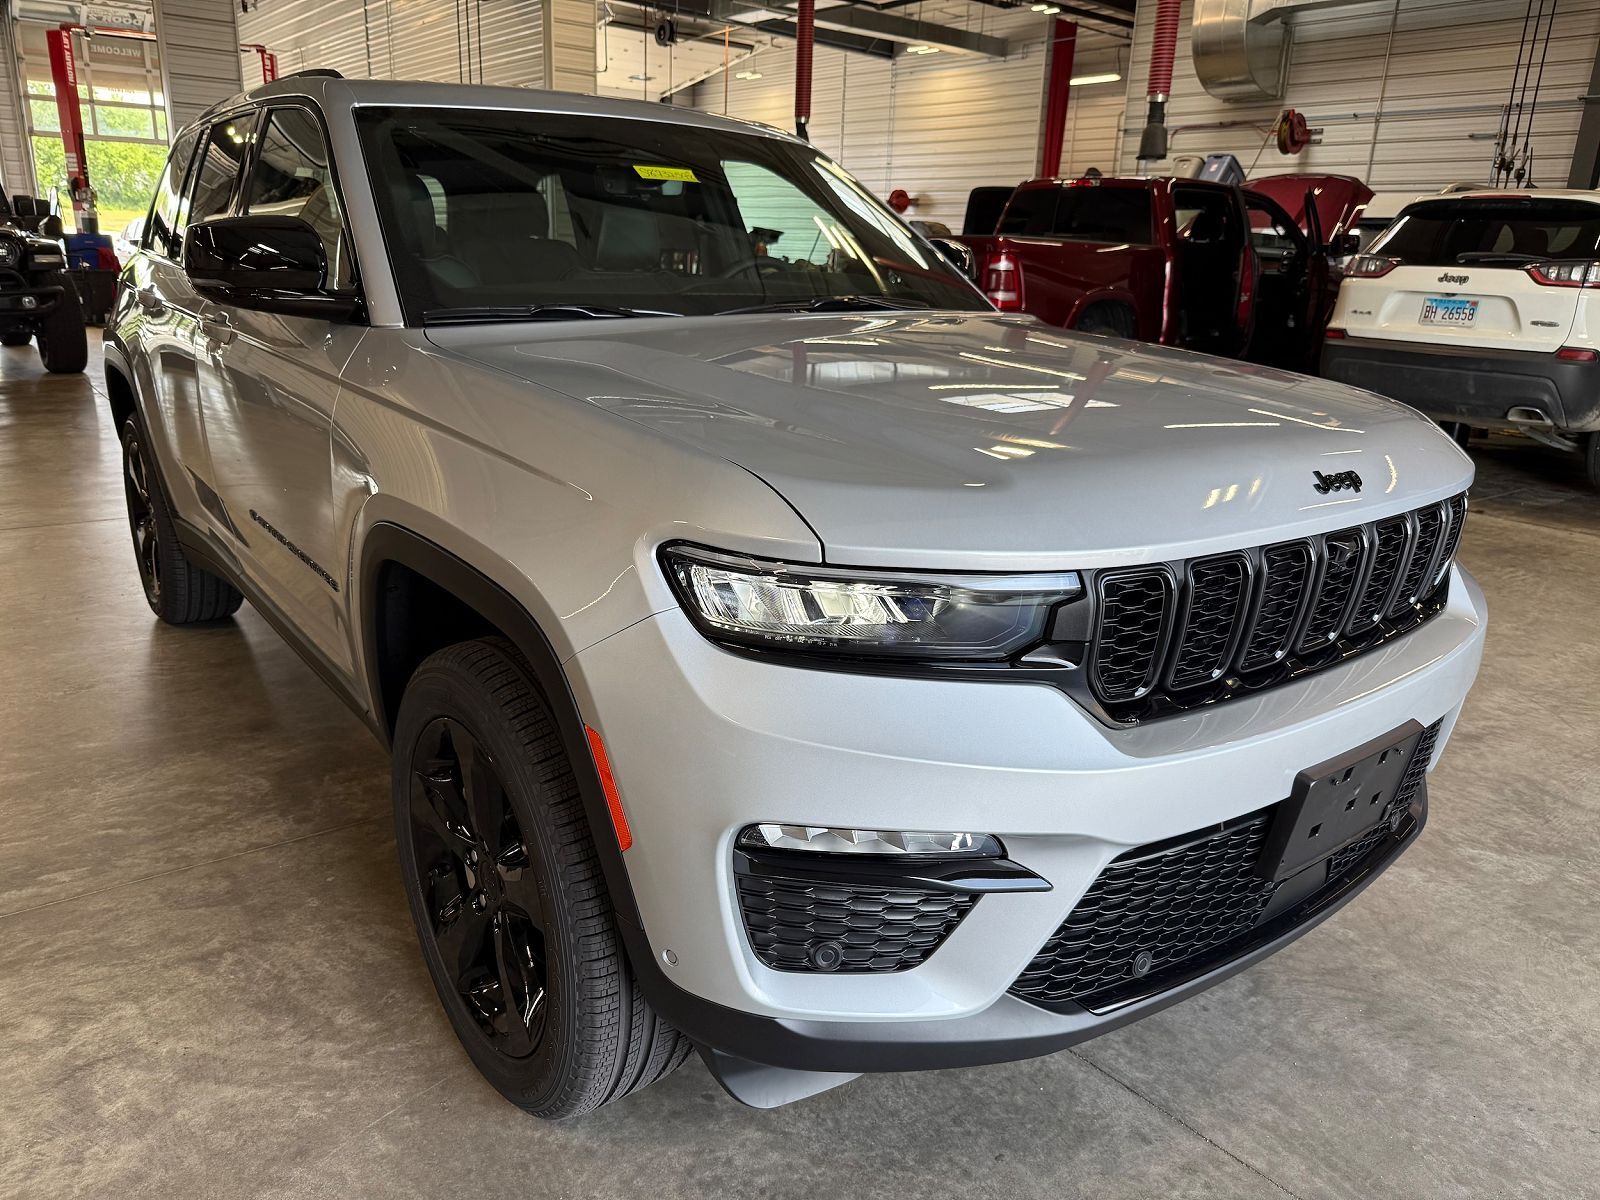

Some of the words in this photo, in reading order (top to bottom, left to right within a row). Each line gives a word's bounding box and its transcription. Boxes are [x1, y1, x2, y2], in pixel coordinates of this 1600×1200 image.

[61, 30, 71, 49] LIFT
[63, 49, 76, 83] ROTARY
[263, 53, 271, 69] LIFT
[1437, 272, 1470, 286] Jeep
[1441, 306, 1475, 321] 26558
[1312, 470, 1363, 495] Jeep
